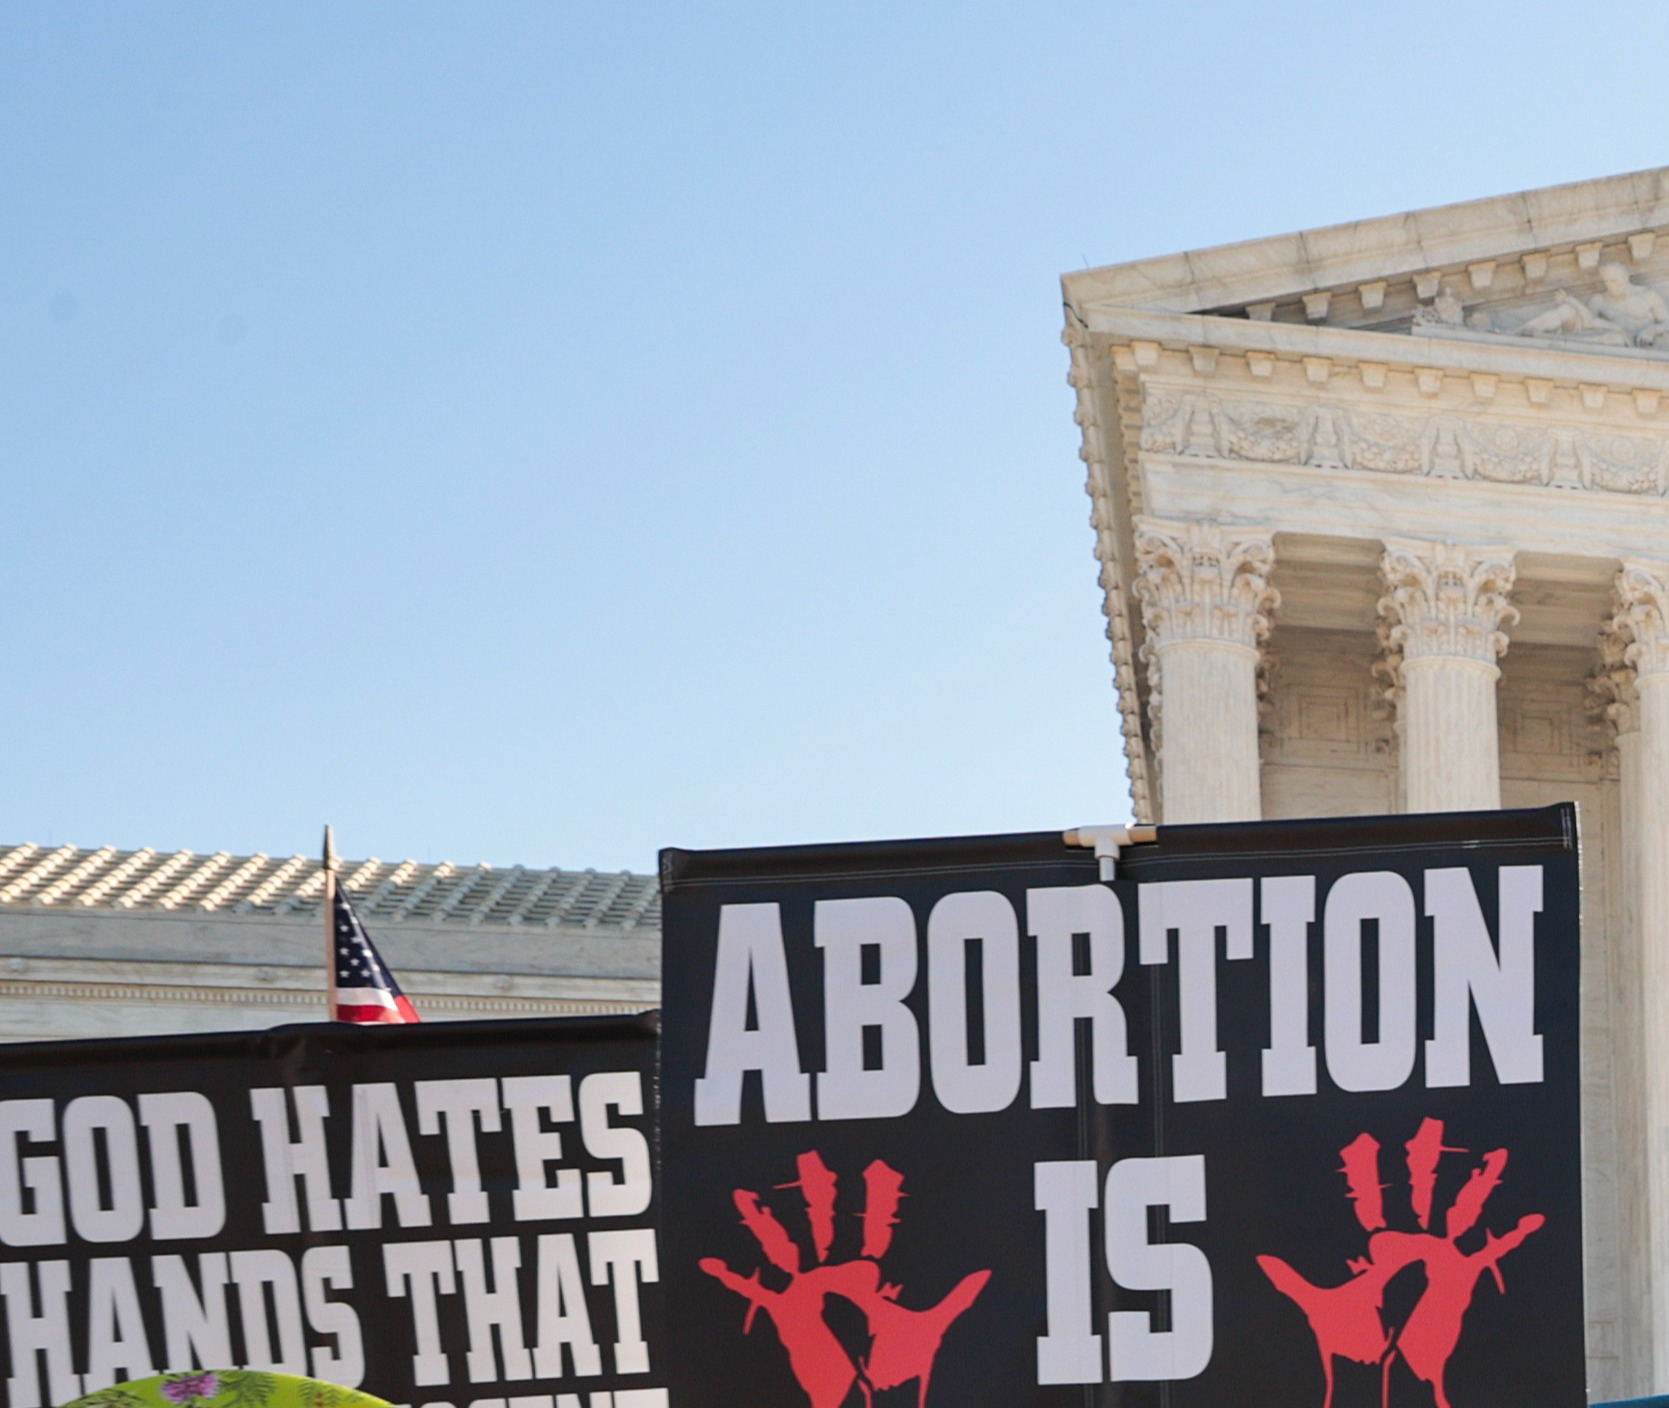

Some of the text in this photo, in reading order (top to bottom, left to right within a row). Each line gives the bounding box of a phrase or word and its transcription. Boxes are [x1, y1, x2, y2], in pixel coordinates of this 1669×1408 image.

[694, 864, 1545, 1127] ABORTION
[0, 1071, 653, 1247] GOD HATES
[383, 1228, 658, 1388] THAT
[1034, 1154, 1215, 1386] IS
